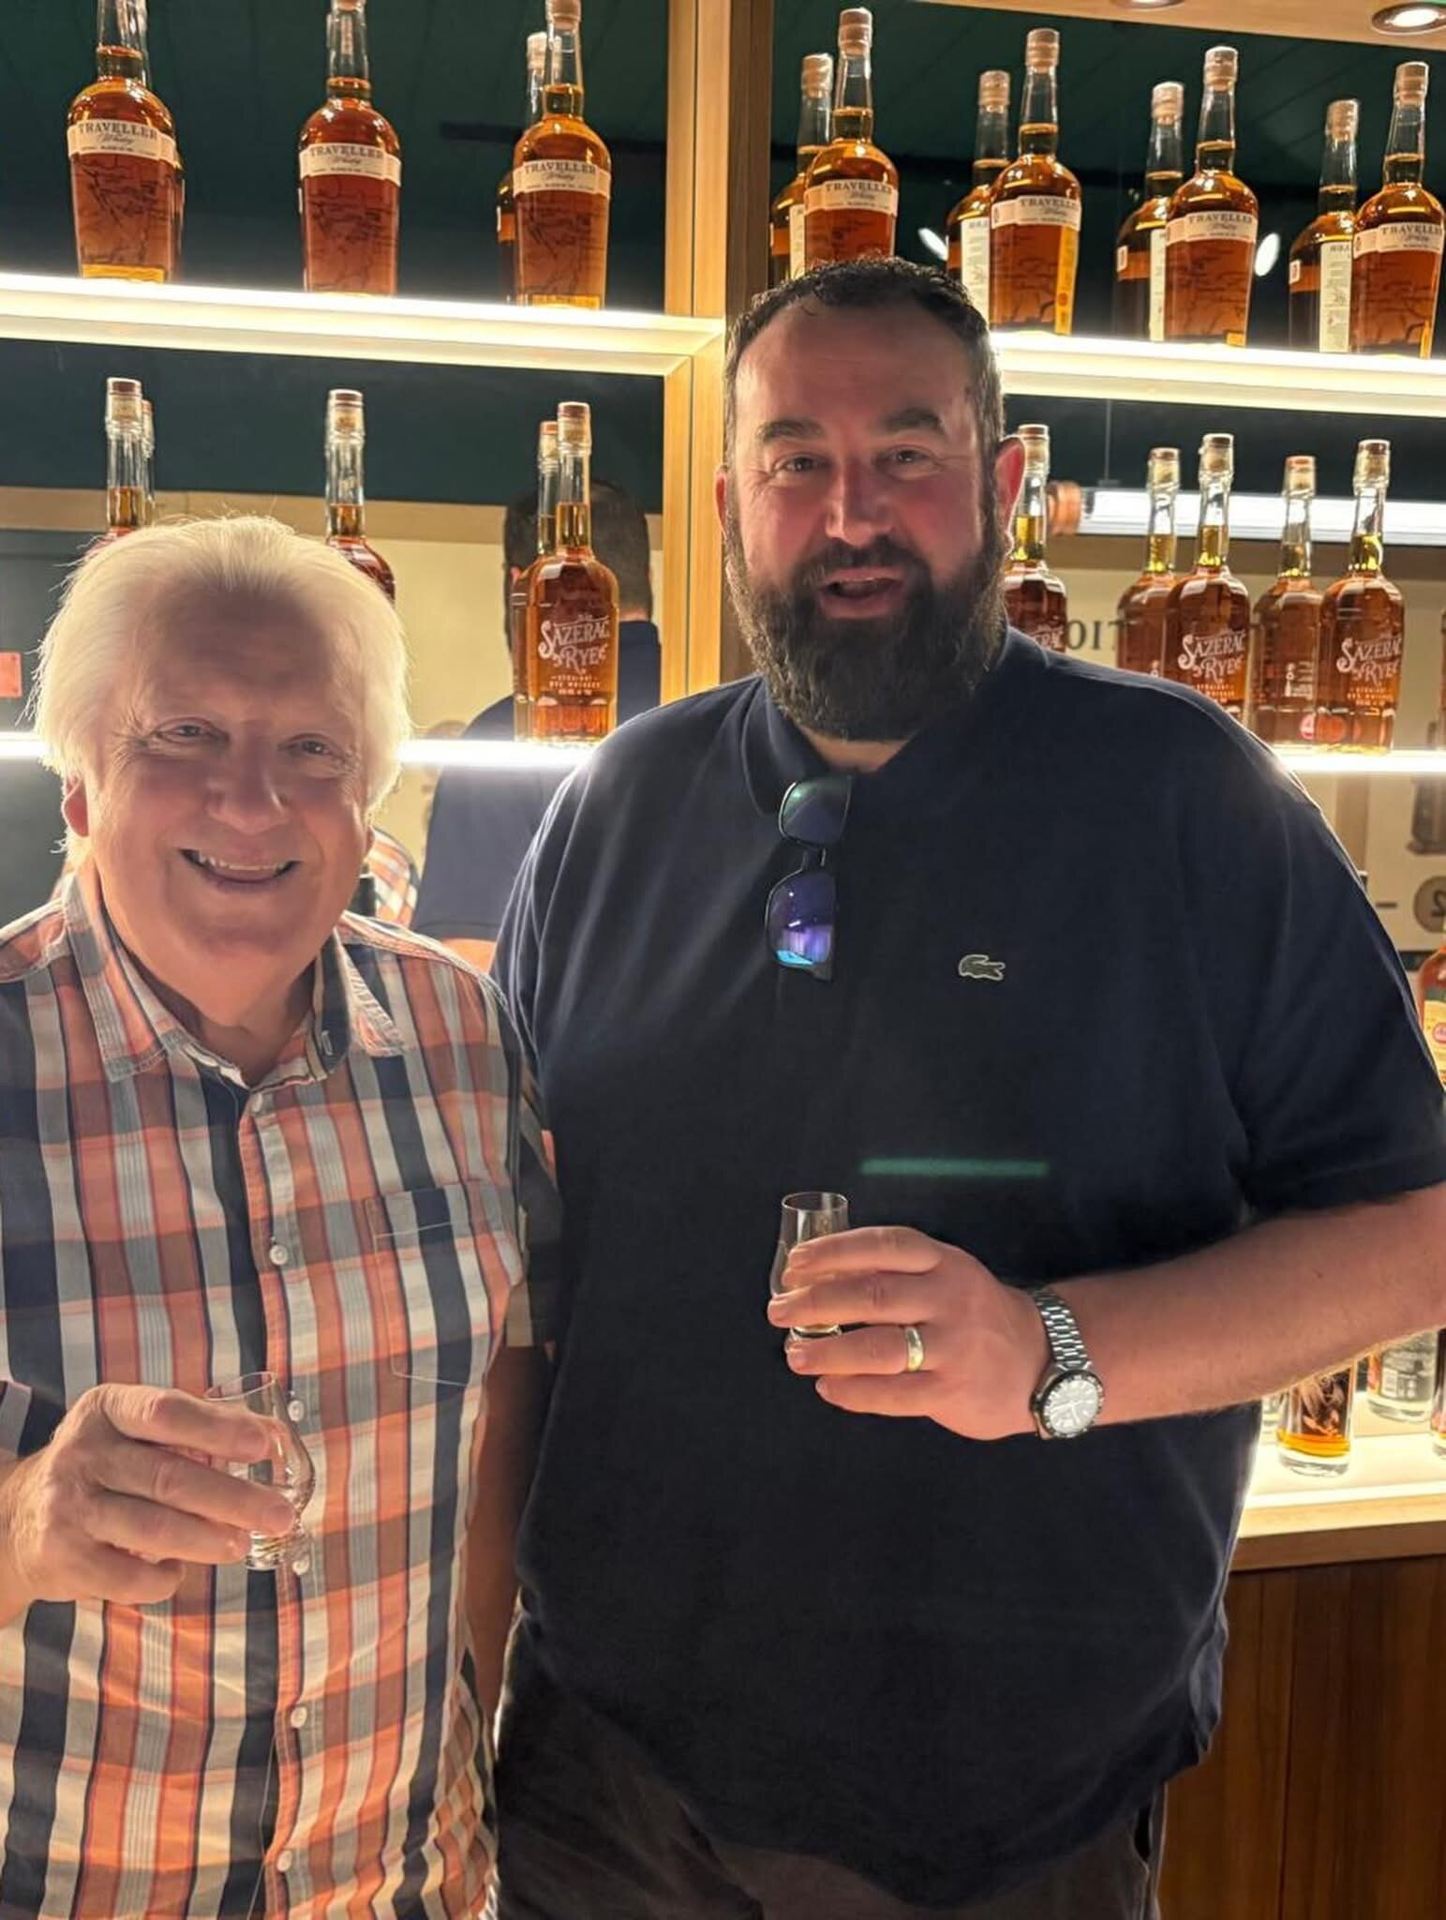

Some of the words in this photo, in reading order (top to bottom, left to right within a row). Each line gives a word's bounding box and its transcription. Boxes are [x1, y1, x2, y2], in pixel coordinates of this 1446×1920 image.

[77, 121, 158, 140] TRAVELLER
[309, 144, 385, 160] TRAVELLER
[523, 161, 596, 175] TRAVELLER
[825, 181, 893, 195] TRAVELLER
[537, 619, 611, 660] SAZERAC
[1177, 630, 1247, 670] SAZERAC
[1336, 637, 1402, 673] SAZERAC
